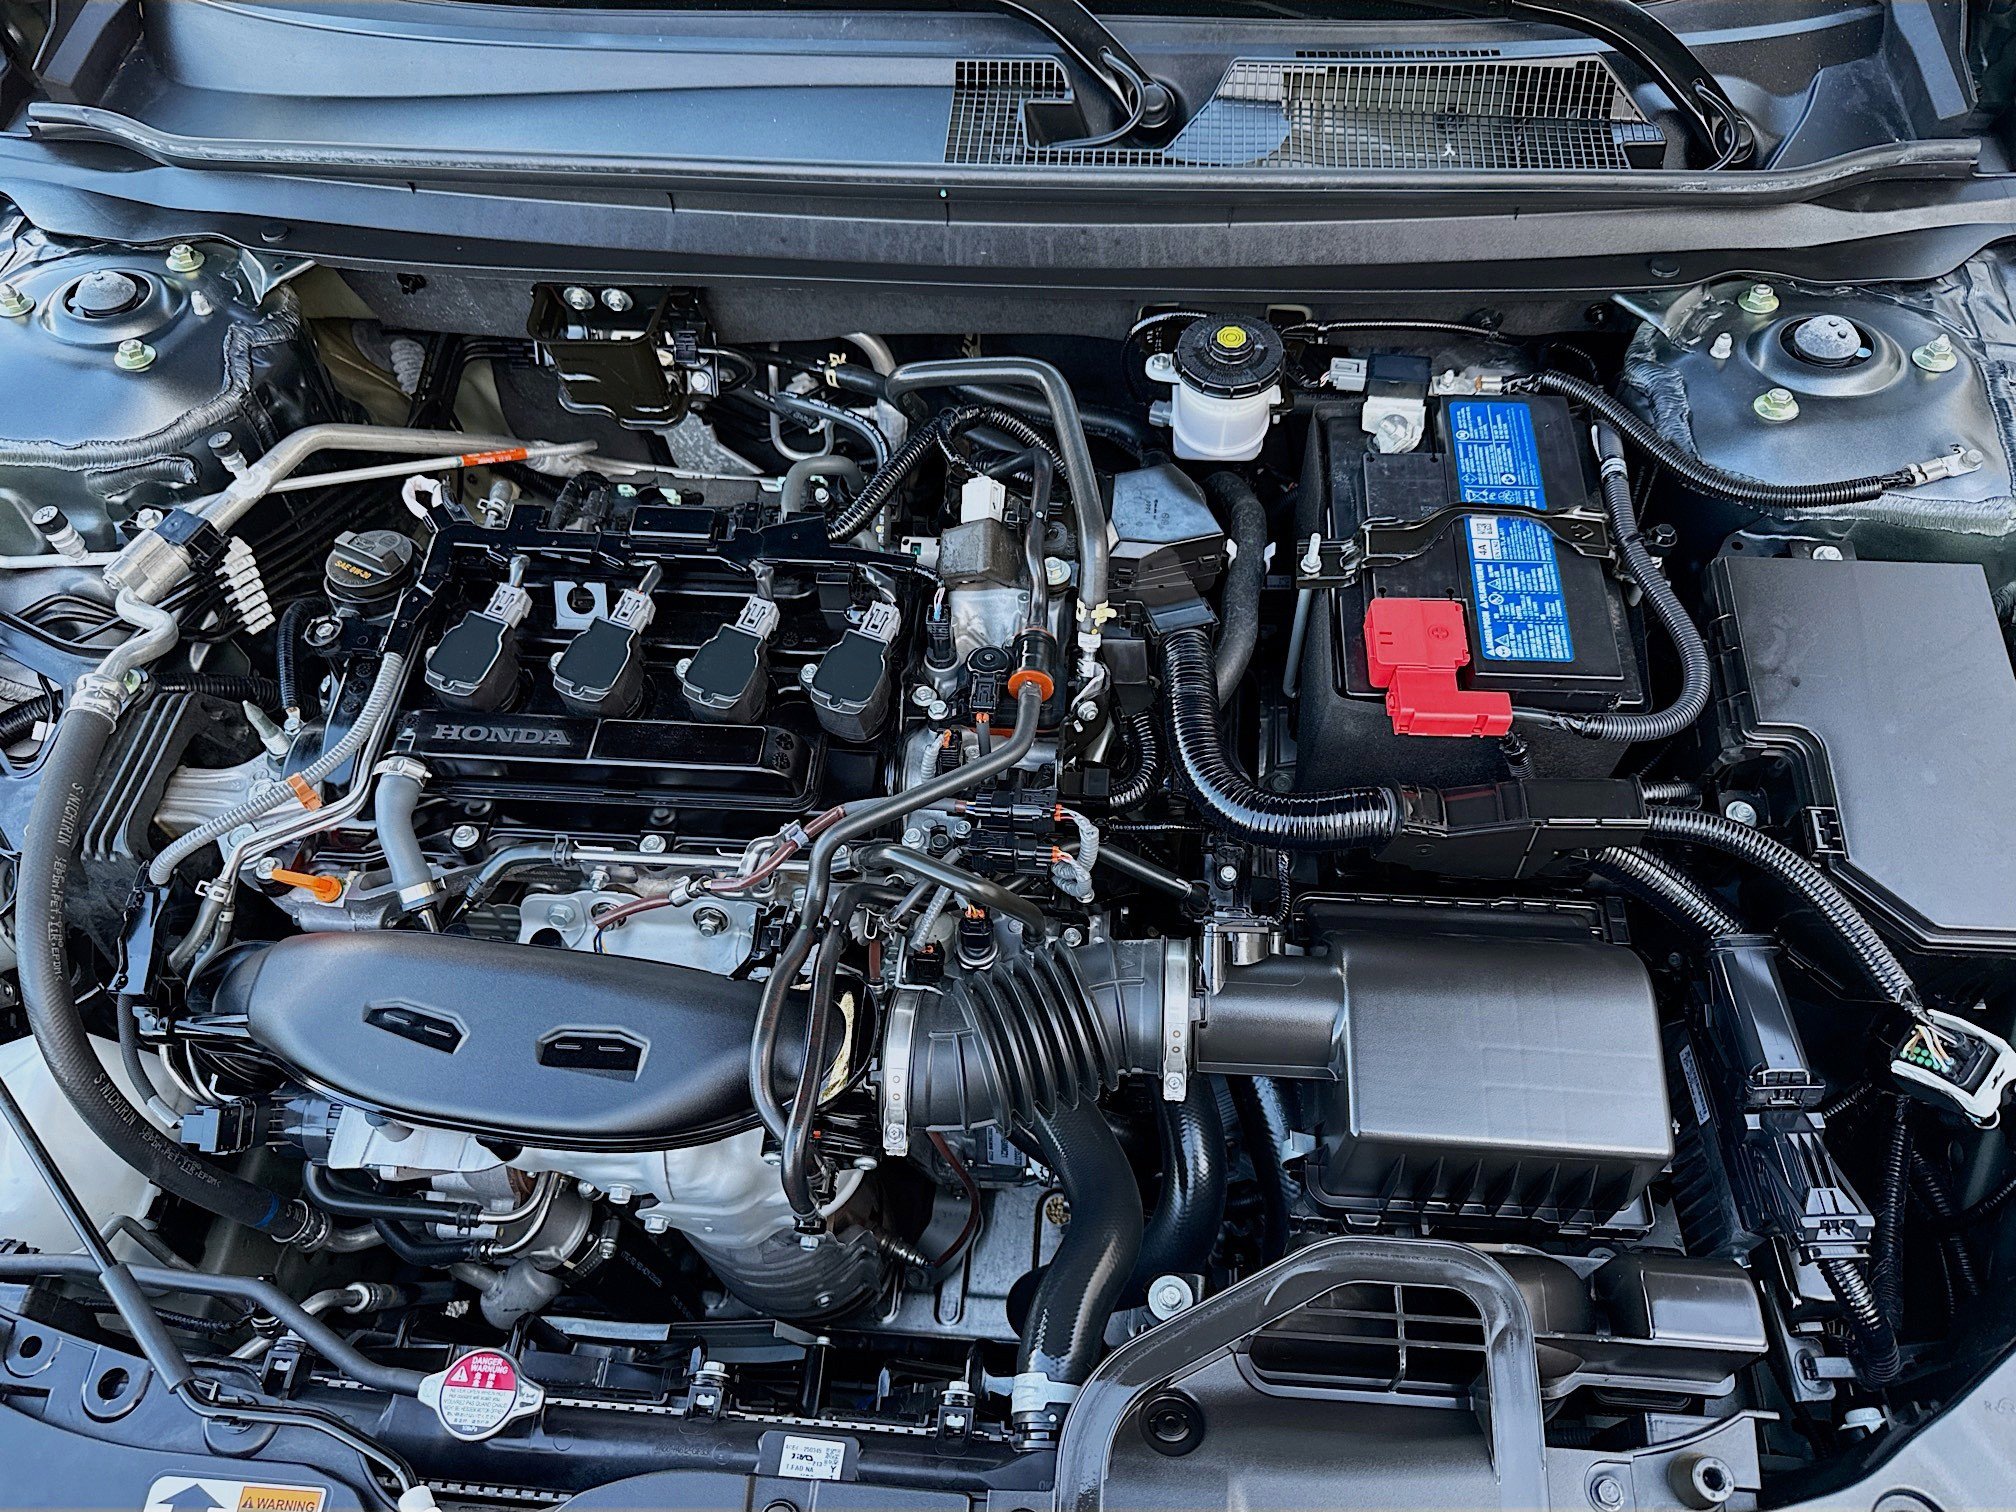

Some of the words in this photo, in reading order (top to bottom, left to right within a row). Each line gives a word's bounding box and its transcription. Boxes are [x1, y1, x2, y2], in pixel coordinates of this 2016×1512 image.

[1478, 544, 1487, 556] 4A
[334, 560, 350, 571] SAE
[431, 724, 571, 746] HONDA
[471, 1356, 504, 1366] DANGER
[257, 1498, 316, 1512] WARNING
